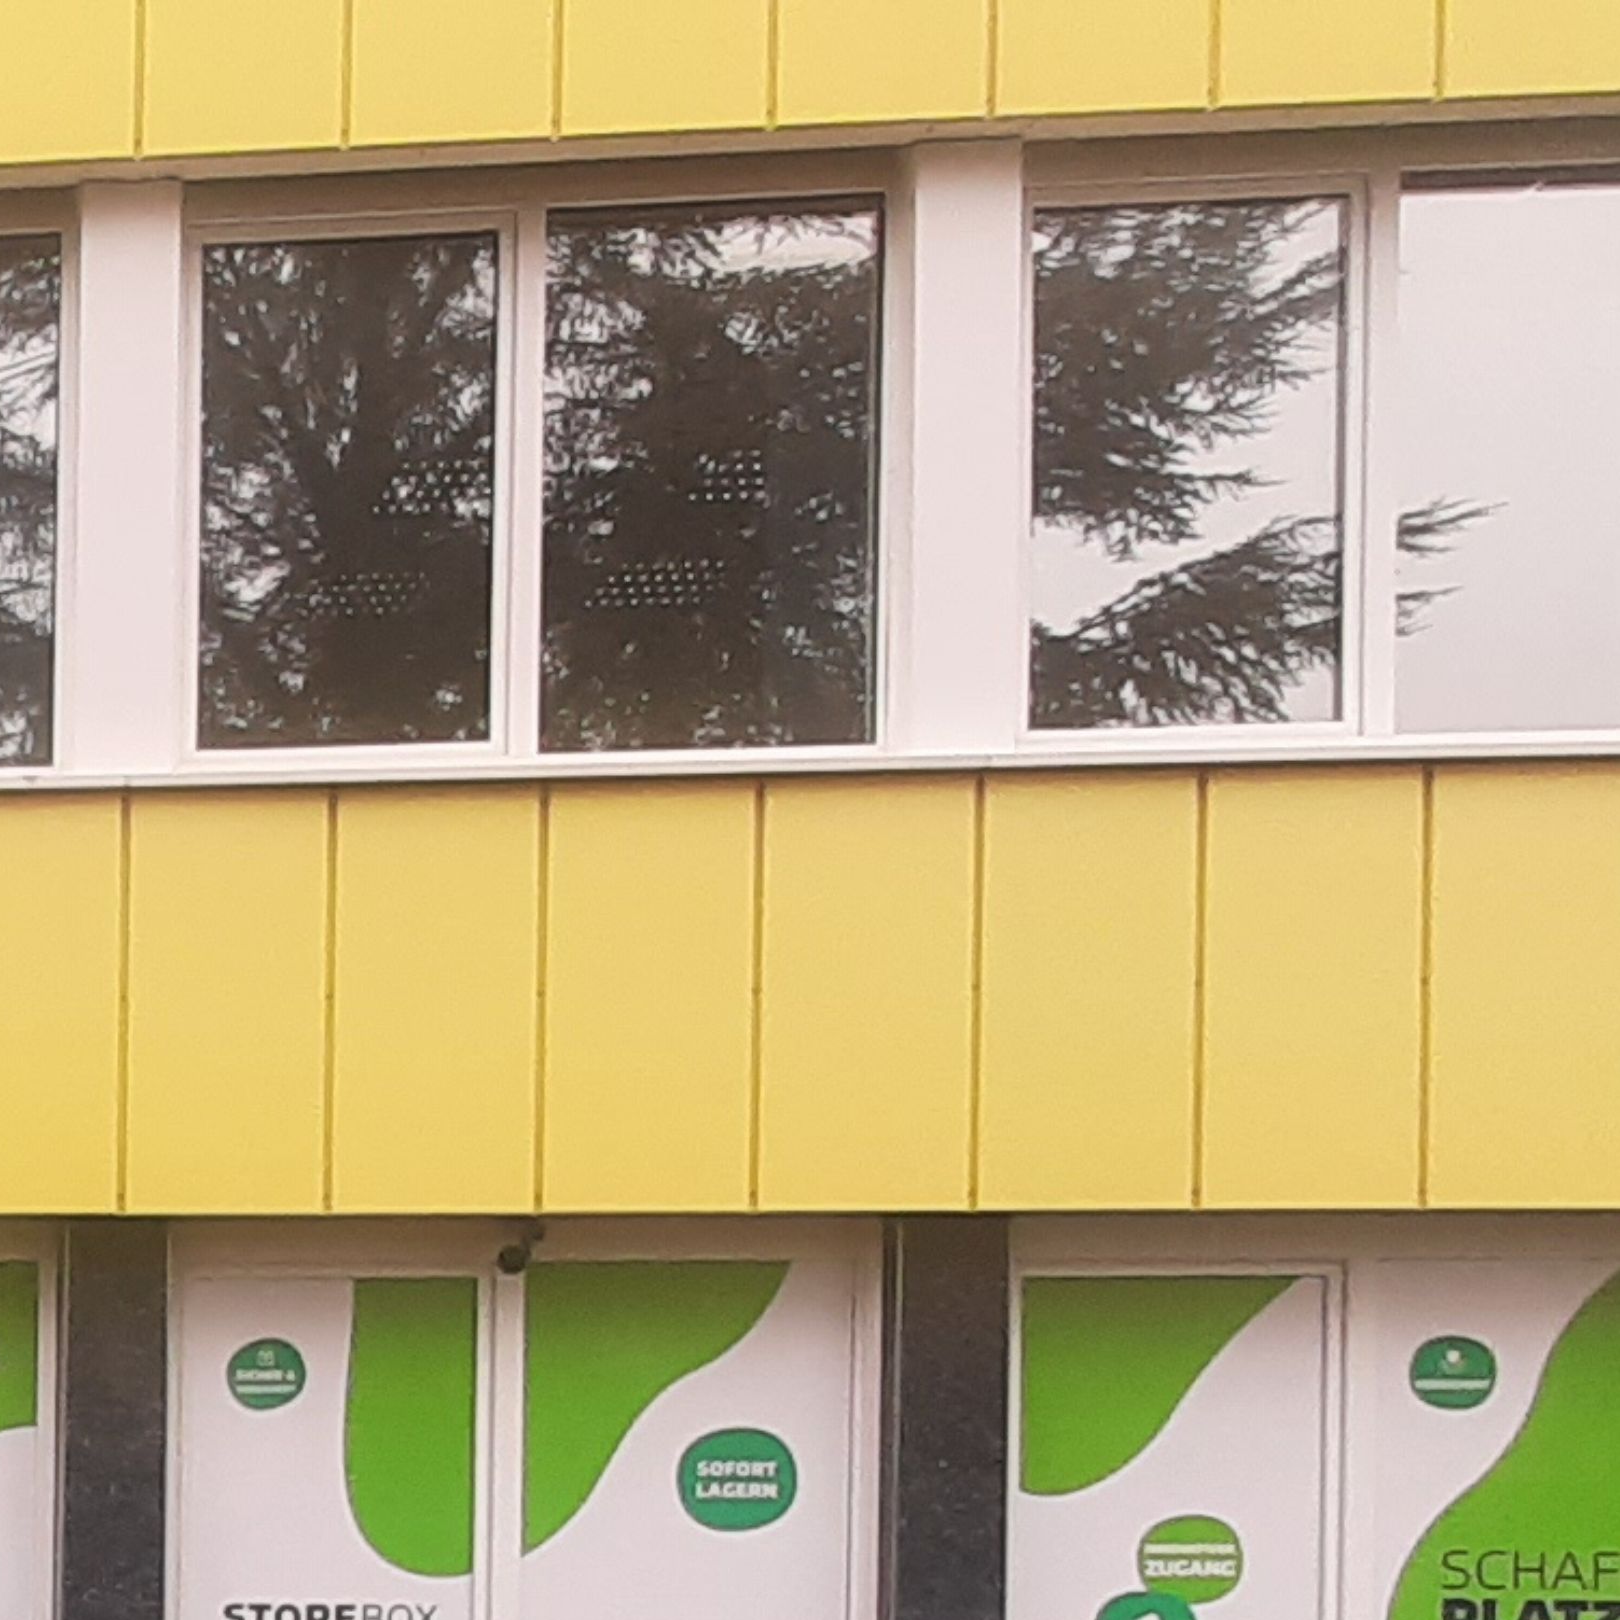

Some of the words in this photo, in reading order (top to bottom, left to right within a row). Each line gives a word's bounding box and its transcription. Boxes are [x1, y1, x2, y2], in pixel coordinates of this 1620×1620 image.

[696, 1460, 778, 1477] SOFORT
[695, 1481, 779, 1499] LAGERN
[1143, 1558, 1237, 1576] ZUGANG
